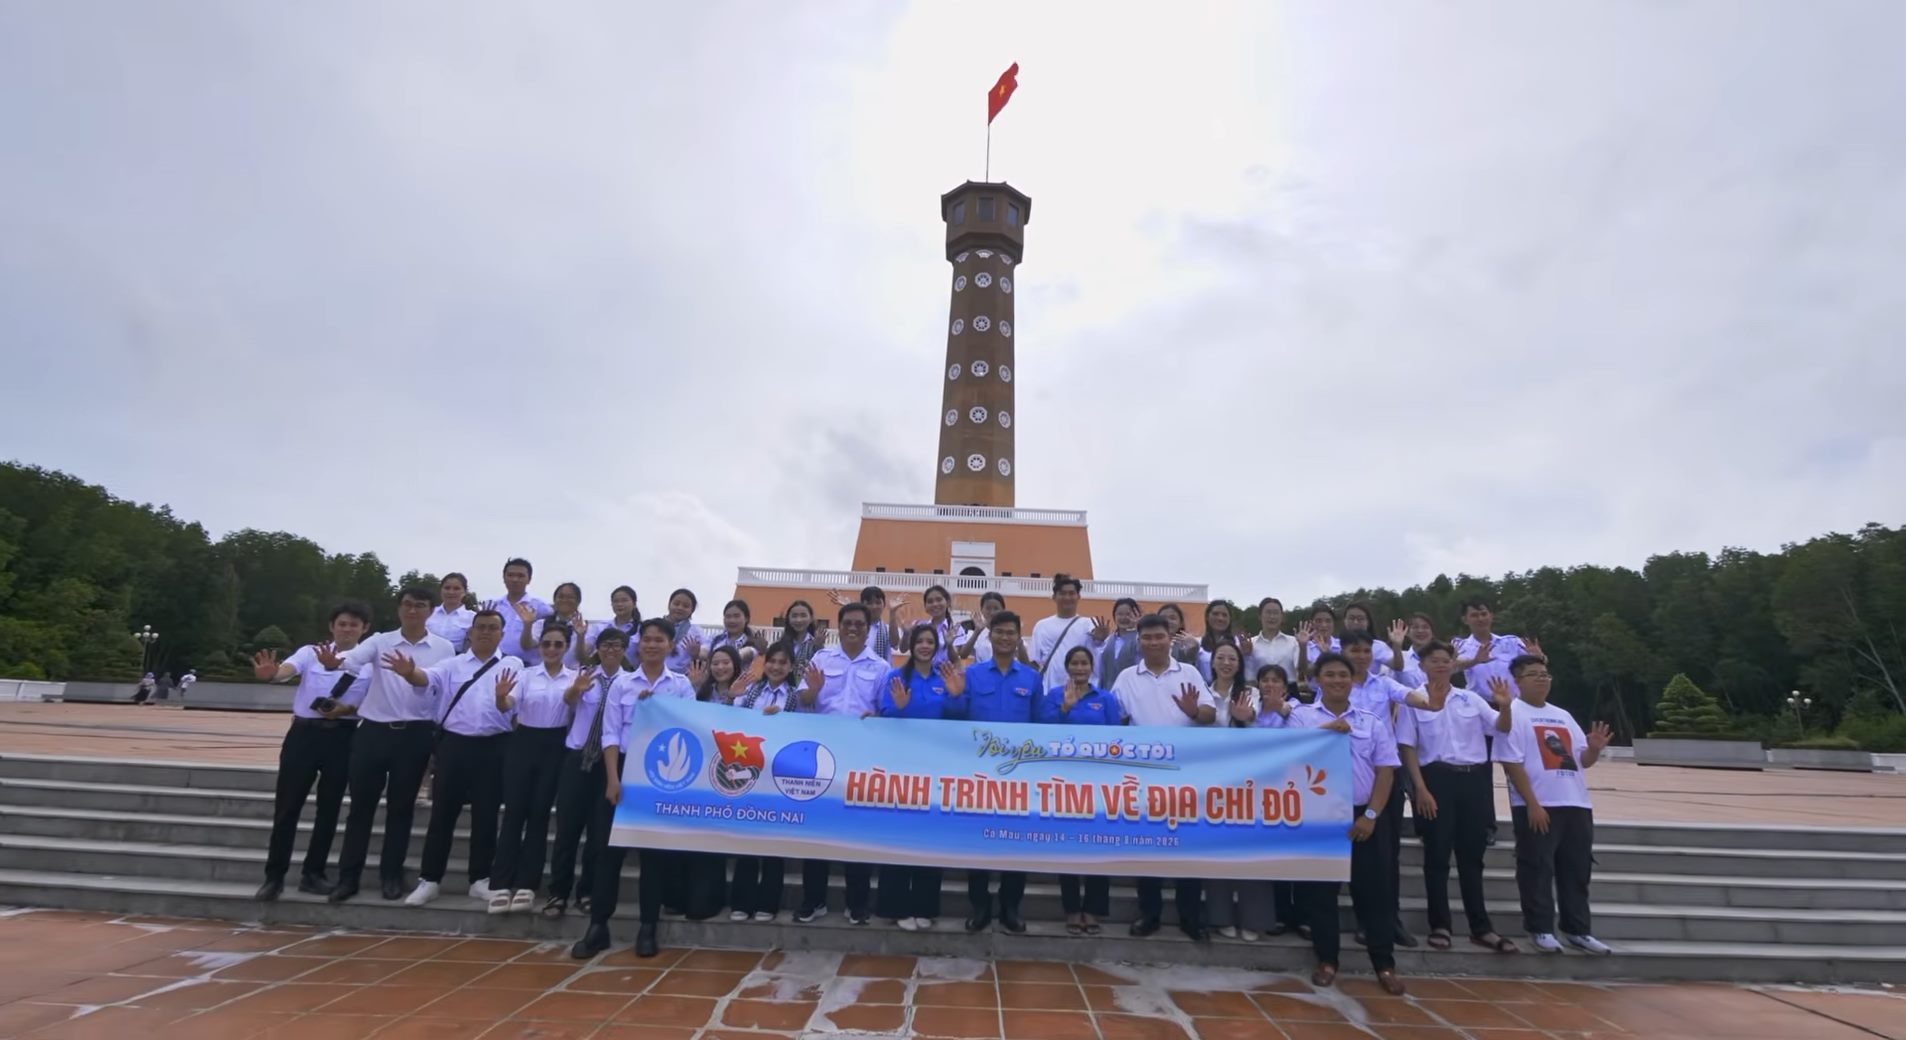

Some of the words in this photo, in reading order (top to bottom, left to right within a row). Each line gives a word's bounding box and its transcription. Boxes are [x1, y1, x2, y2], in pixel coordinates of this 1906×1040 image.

[1080, 738, 1137, 760] QUỐC
[845, 767, 931, 810] HÀNH
[939, 773, 1029, 816] TRÌNH
[1037, 777, 1095, 819] TÌM
[1101, 774, 1141, 820] VỀ
[1147, 784, 1198, 829] ĐỊA
[1205, 779, 1255, 824] CHỈ
[1262, 780, 1302, 826] ĐỎ
[704, 804, 733, 819] PHỐ
[736, 806, 777, 822] ĐỒNG
[780, 812, 804, 824] NAI
